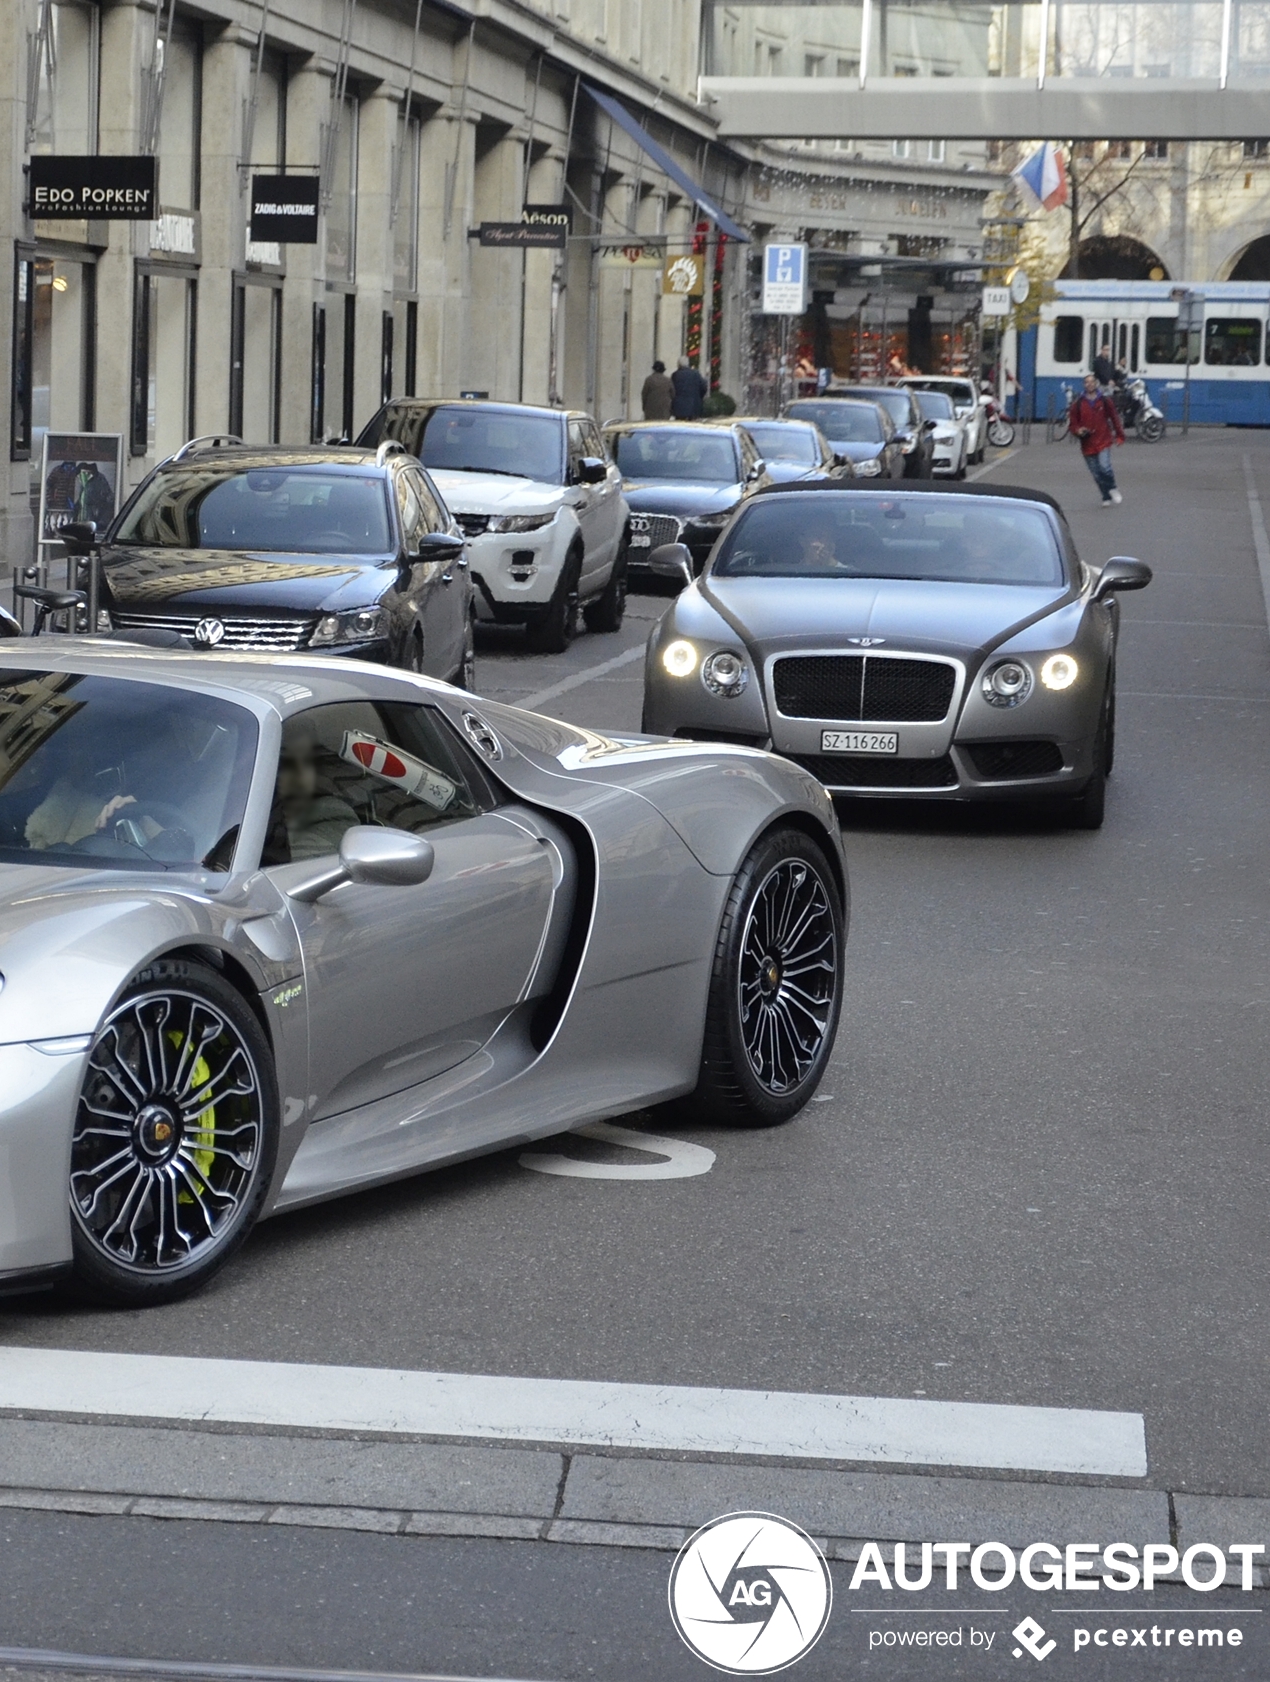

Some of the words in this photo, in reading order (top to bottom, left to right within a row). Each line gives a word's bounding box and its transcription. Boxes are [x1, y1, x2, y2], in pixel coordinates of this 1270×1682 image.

[35, 187, 75, 202] EDO
[82, 187, 147, 203] POPKEN
[105, 203, 147, 213] Lounge
[779, 249, 791, 266] P
[987, 293, 1008, 304] TAXI
[1210, 324, 1219, 335] 7
